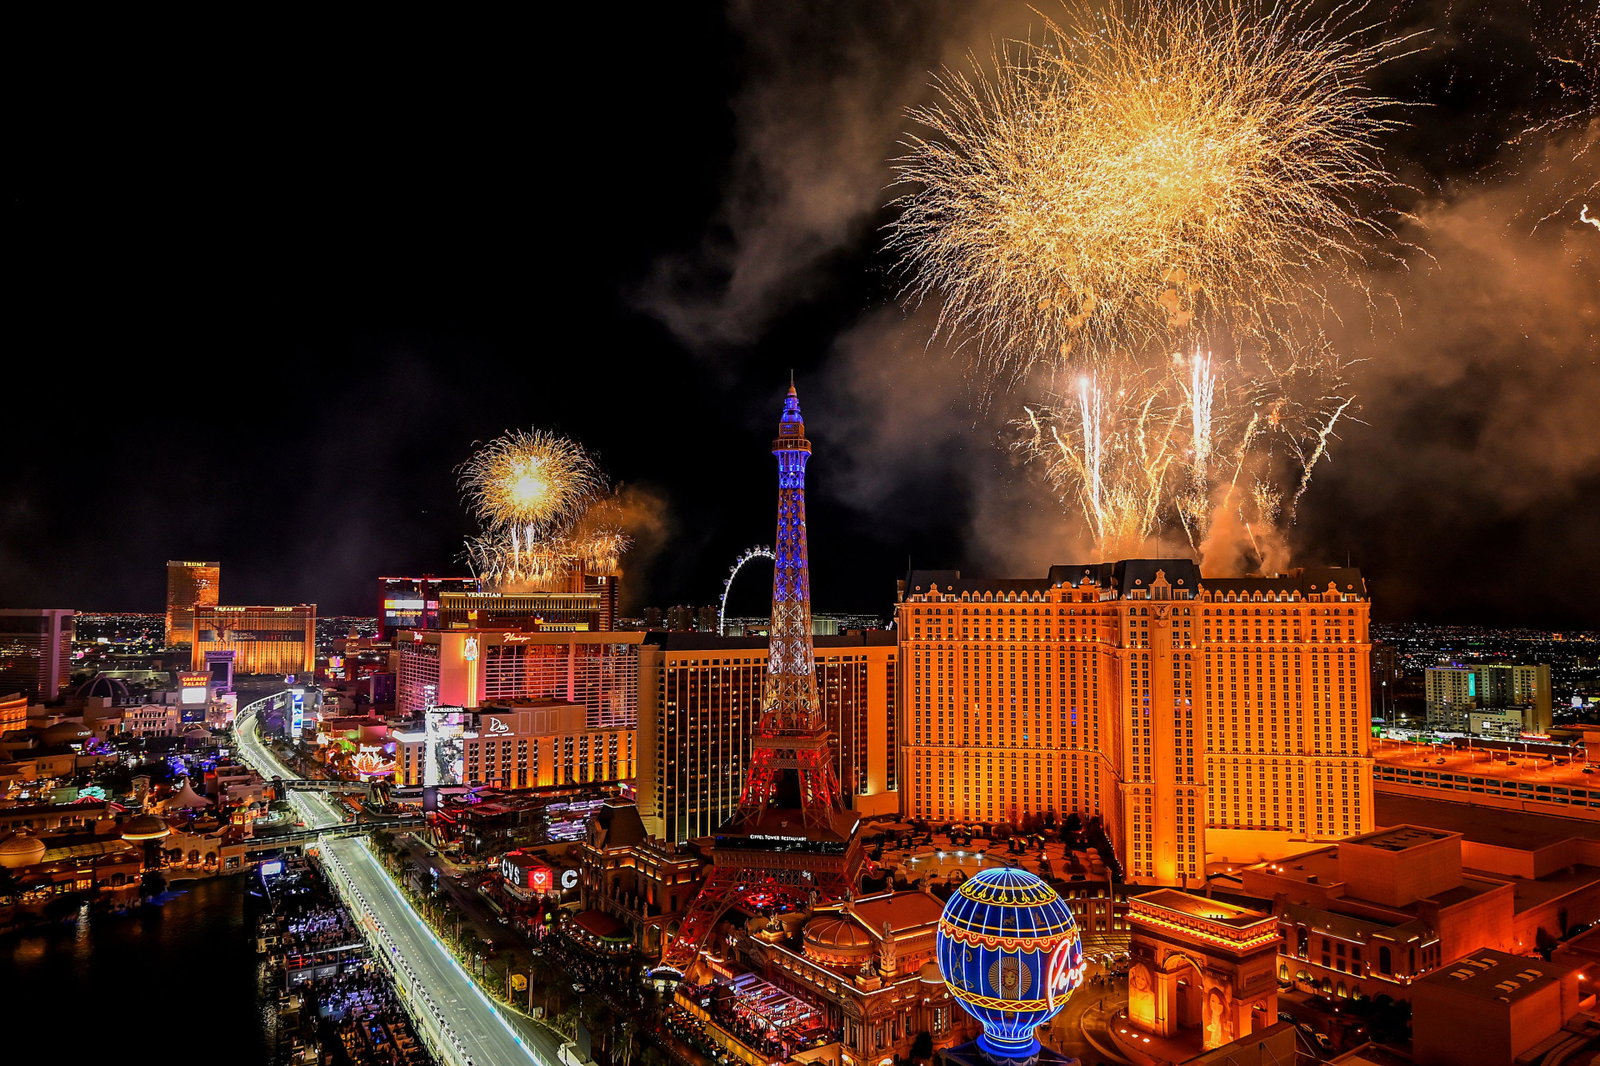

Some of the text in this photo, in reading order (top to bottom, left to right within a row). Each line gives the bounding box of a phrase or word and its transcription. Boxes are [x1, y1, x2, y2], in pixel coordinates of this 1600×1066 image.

[503, 632, 531, 642] Flamingo
[502, 858, 520, 885] CVS
[561, 868, 583, 889] C
[1047, 939, 1087, 1013] Paris
